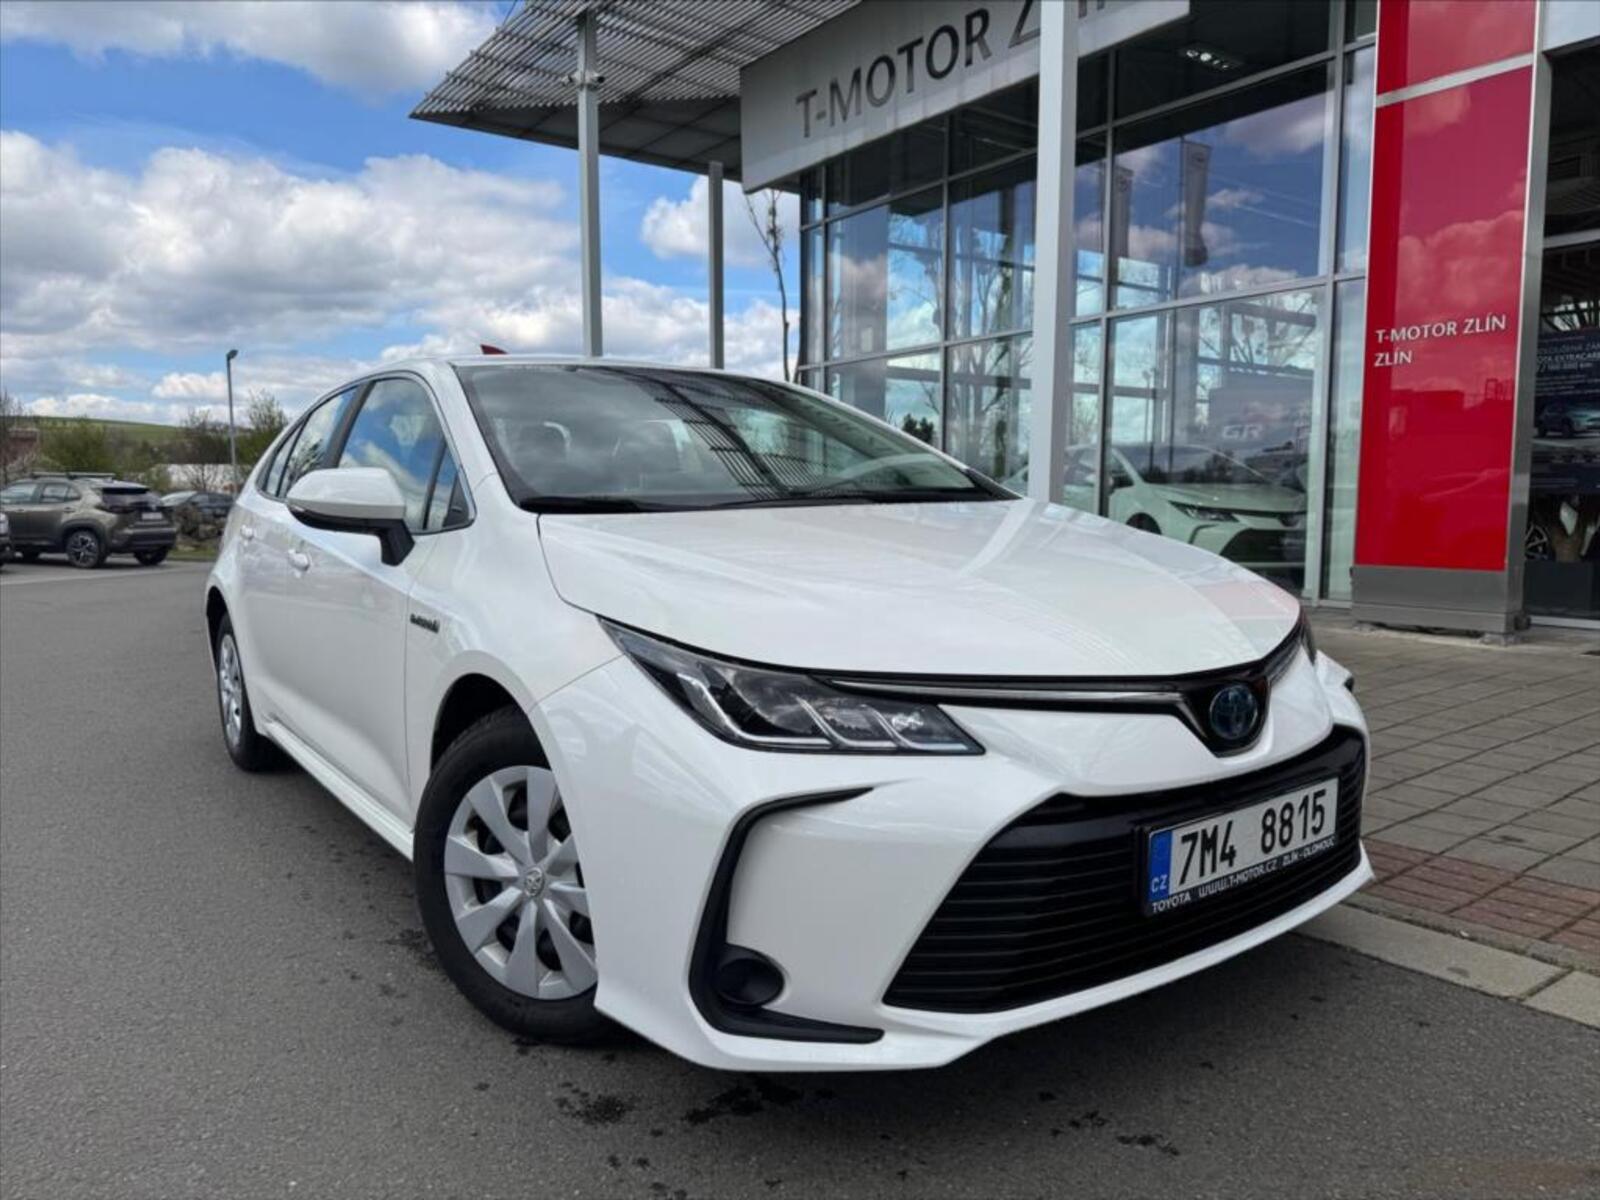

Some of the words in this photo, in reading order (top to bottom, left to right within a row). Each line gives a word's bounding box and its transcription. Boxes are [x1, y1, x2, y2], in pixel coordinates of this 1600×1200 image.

[795, 8, 992, 138] T-MOTOR
[1375, 320, 1457, 344] T-MOTOR
[1463, 311, 1507, 335] ZLÍN
[1373, 347, 1413, 368] ZLÍN
[1178, 820, 1236, 886] 7M4
[1260, 788, 1327, 855] 8815
[1151, 874, 1168, 893] CZ
[1152, 892, 1192, 914] TOYOTA
